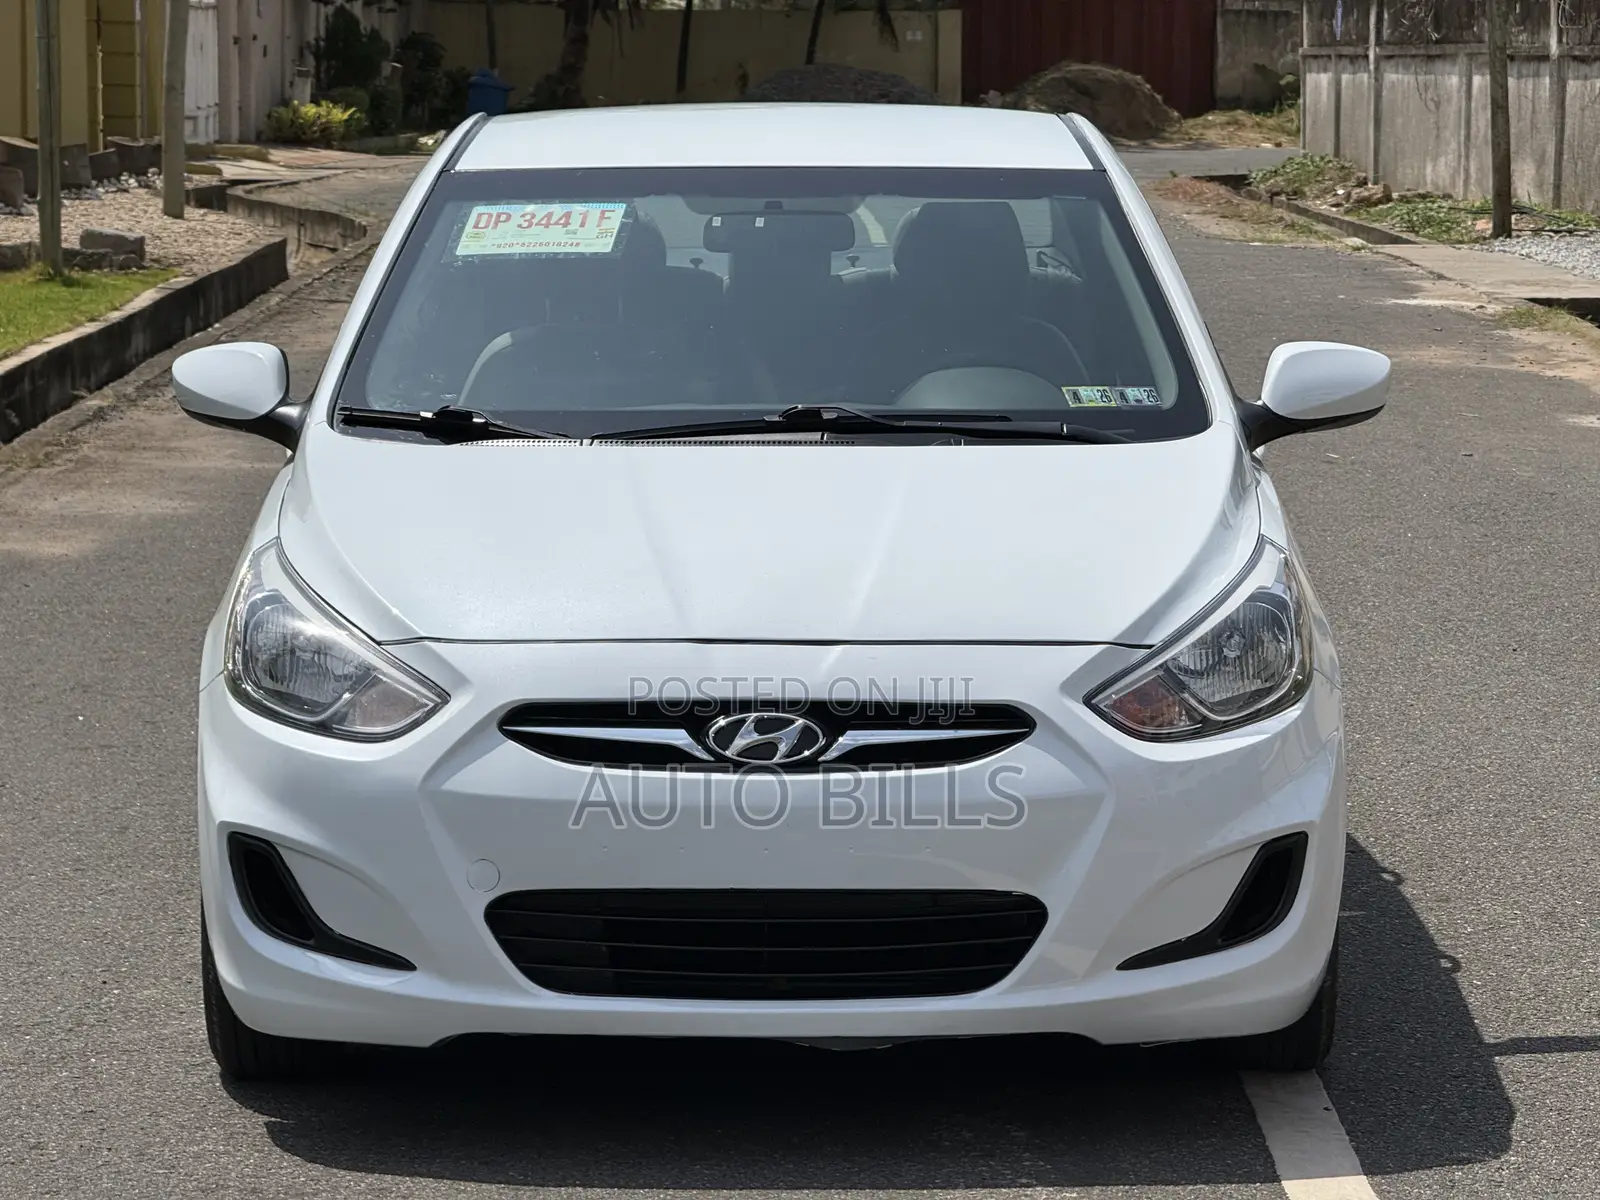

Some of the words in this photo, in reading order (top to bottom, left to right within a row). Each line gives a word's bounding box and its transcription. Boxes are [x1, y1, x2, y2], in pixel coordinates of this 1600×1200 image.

[472, 211, 512, 230] DP
[516, 209, 590, 229] 3441
[596, 209, 616, 228] F
[1096, 388, 1113, 403] 26
[1142, 388, 1159, 403] 26
